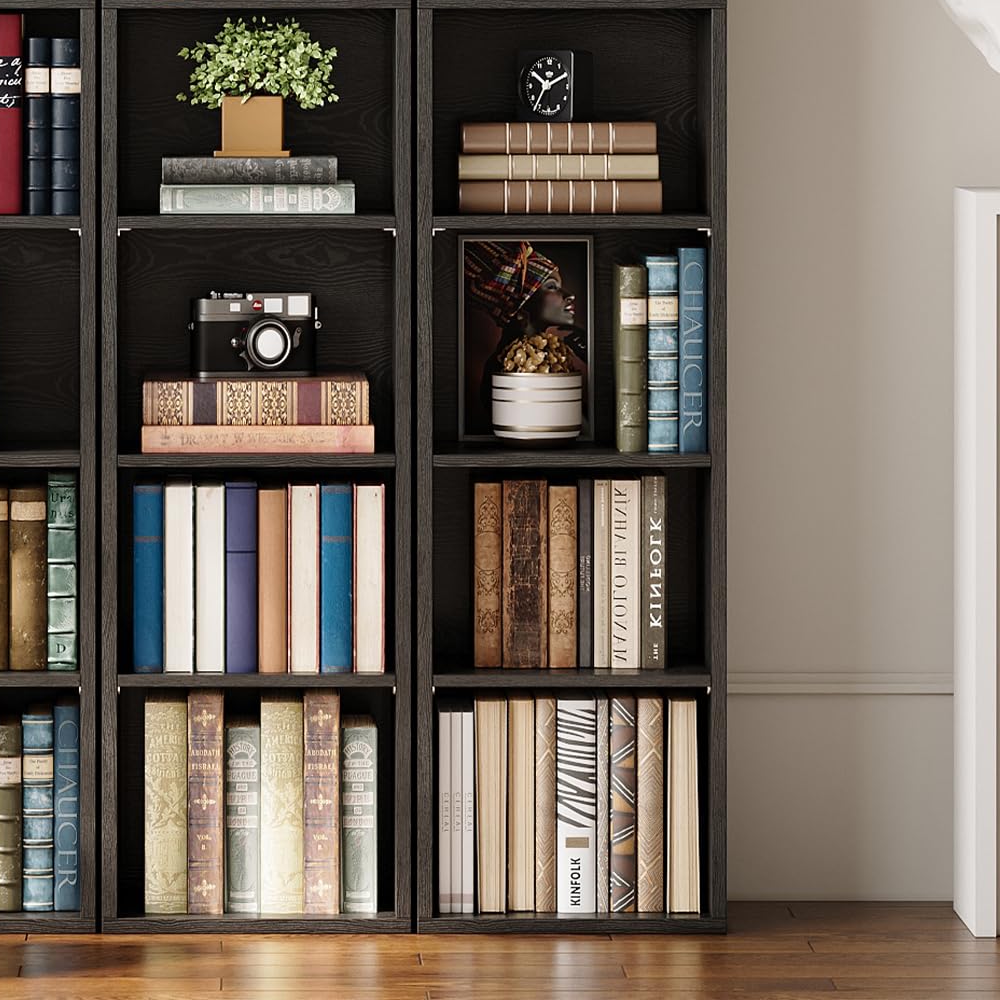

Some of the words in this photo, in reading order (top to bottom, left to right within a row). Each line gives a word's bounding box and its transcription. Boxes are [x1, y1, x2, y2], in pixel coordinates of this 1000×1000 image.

[682, 261, 703, 432] CHAUCER
[56, 643, 66, 654] D
[57, 720, 78, 890] CHAUCER
[570, 857, 581, 906] KINFOLK
